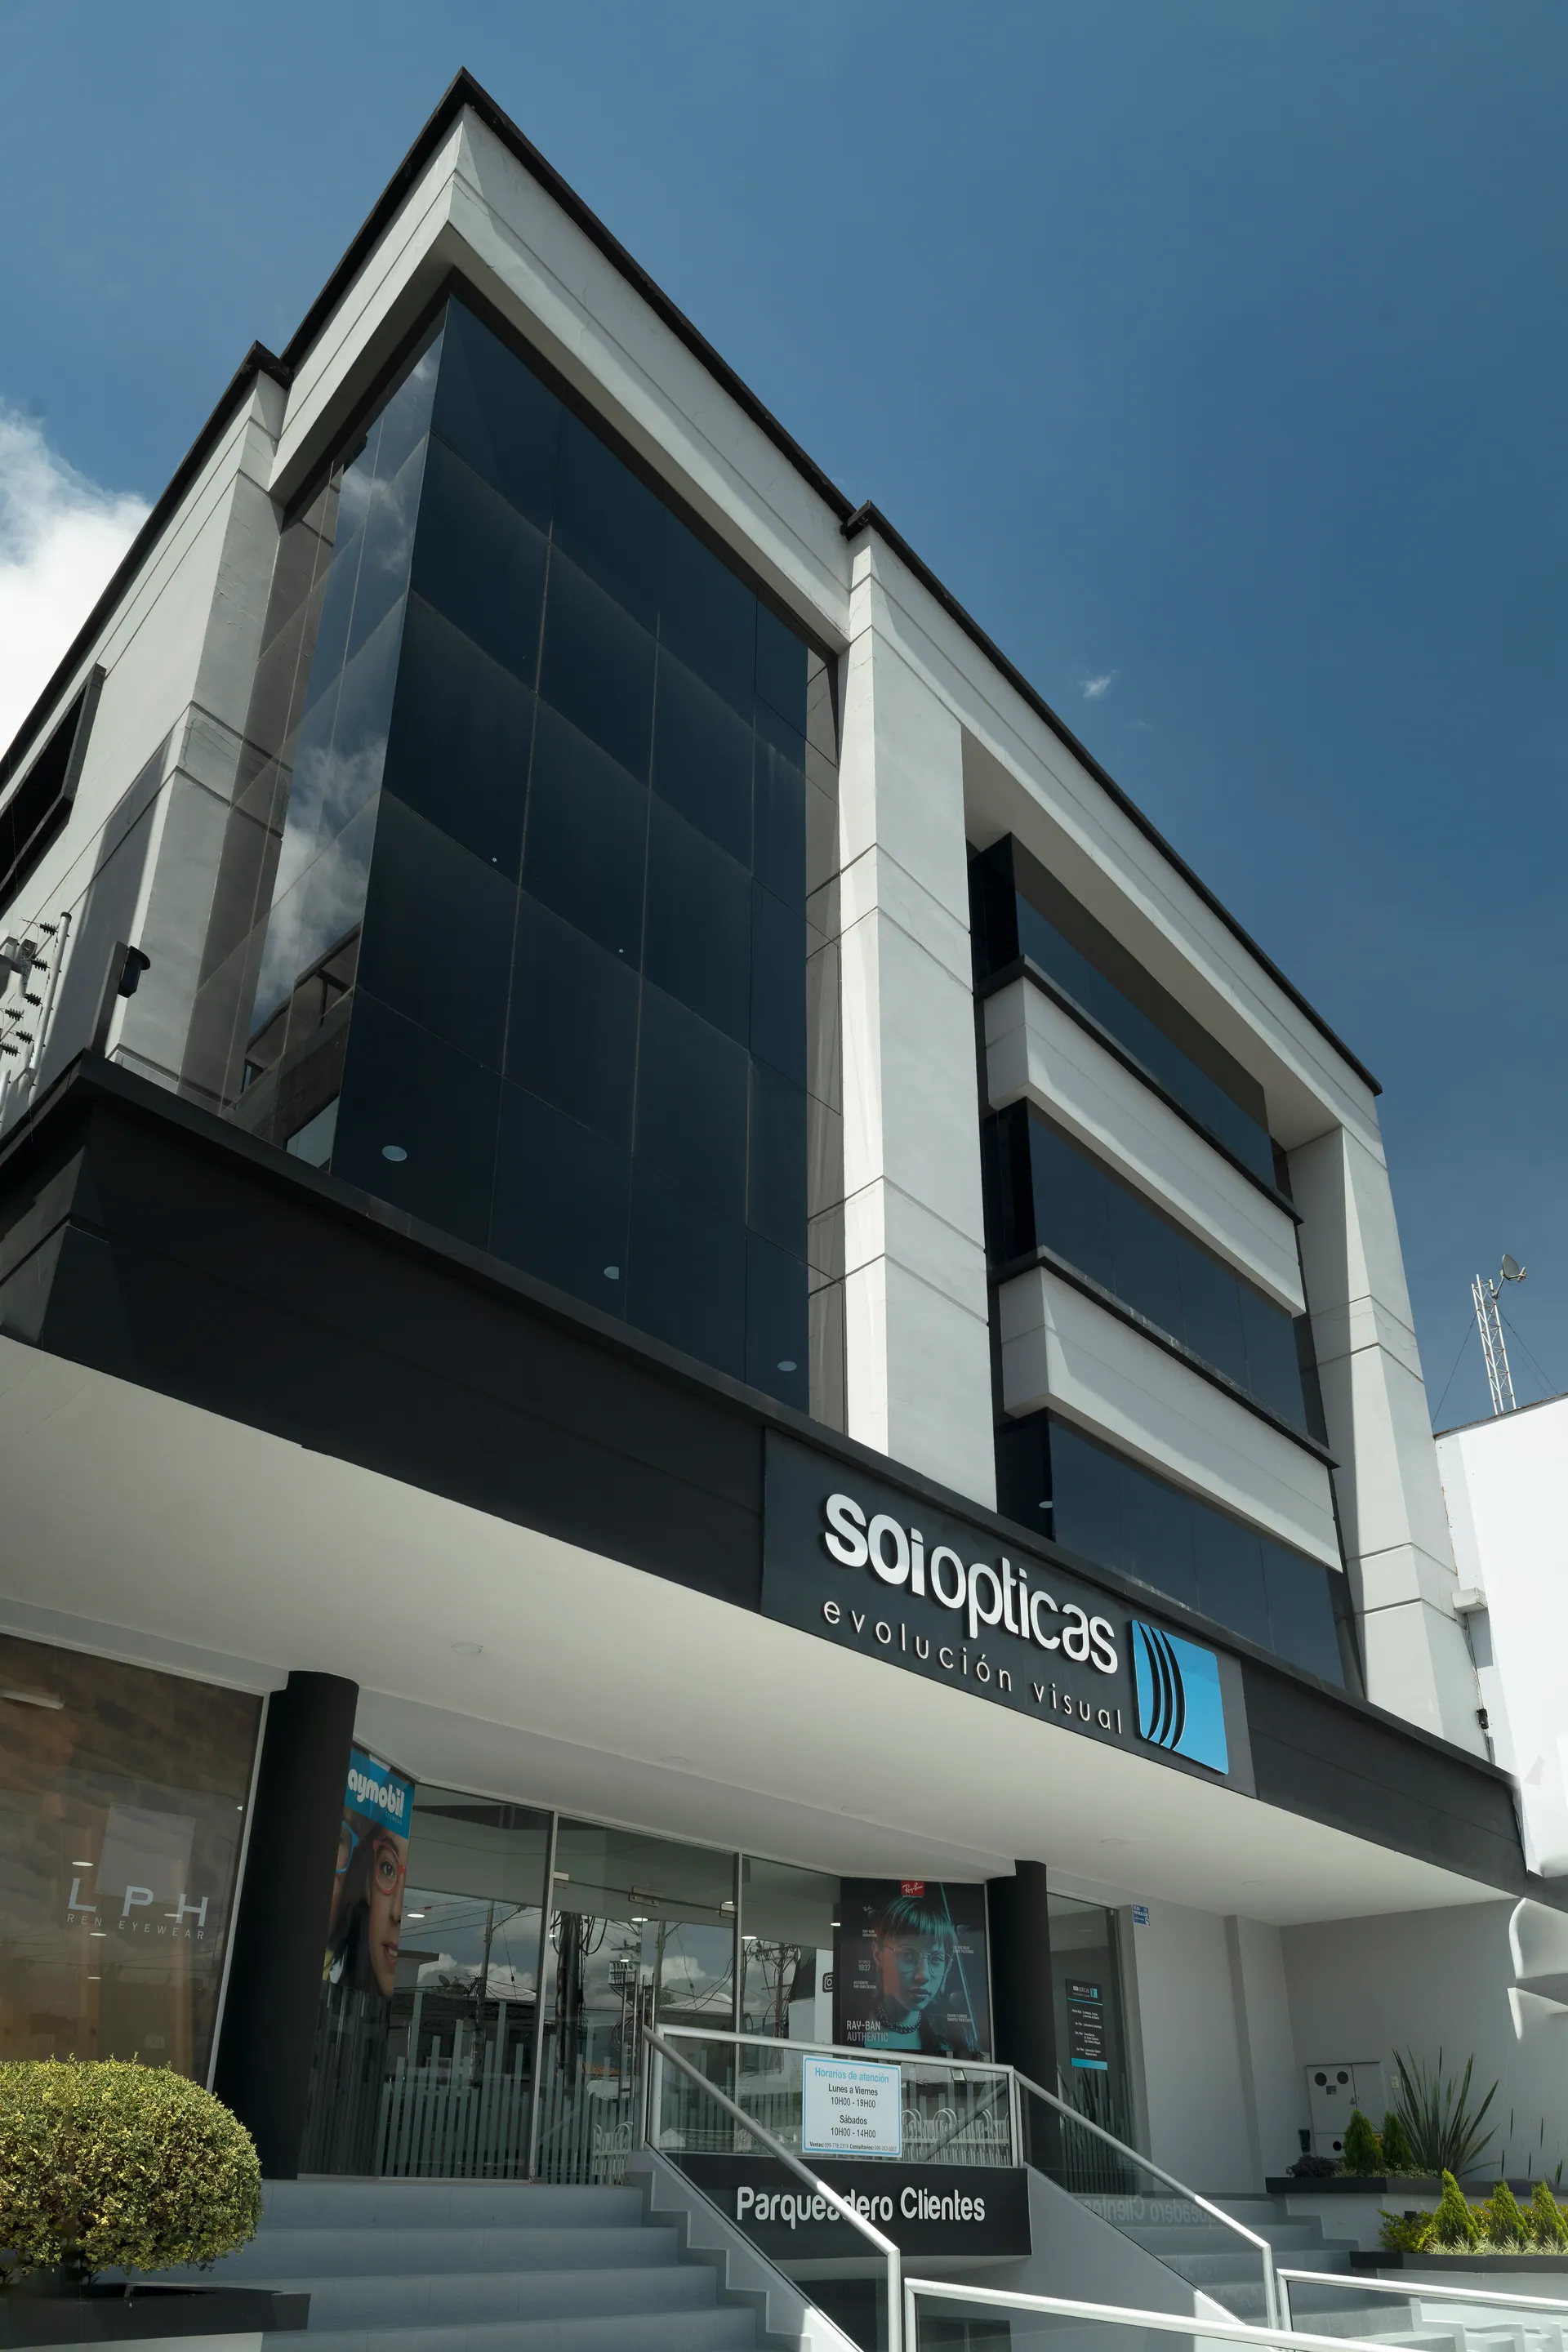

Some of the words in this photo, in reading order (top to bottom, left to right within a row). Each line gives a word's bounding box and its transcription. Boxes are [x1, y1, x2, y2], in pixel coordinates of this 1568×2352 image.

[824, 1601, 1012, 1692] evolución
[1034, 1682, 1122, 1735] visual
[347, 1768, 405, 1818] aymobil
[67, 1913, 102, 1927] REN
[118, 1920, 204, 1940] EYEWEAR
[846, 2020, 880, 2030] RAY-BAN
[847, 2031, 889, 2042] AUTHENTIC
[815, 2067, 846, 2079] Horarios
[848, 2070, 858, 2080] de
[859, 2073, 889, 2083] atención
[828, 2083, 848, 2094] Lunes
[854, 2086, 878, 2096] Viernes
[831, 2096, 851, 2106] 10H00
[857, 2099, 876, 2108] 19H00
[840, 2114, 867, 2125] Sábados
[831, 2127, 851, 2136] 10H00
[857, 2129, 876, 2138] 14H00
[900, 2186, 986, 2221] Clientes
